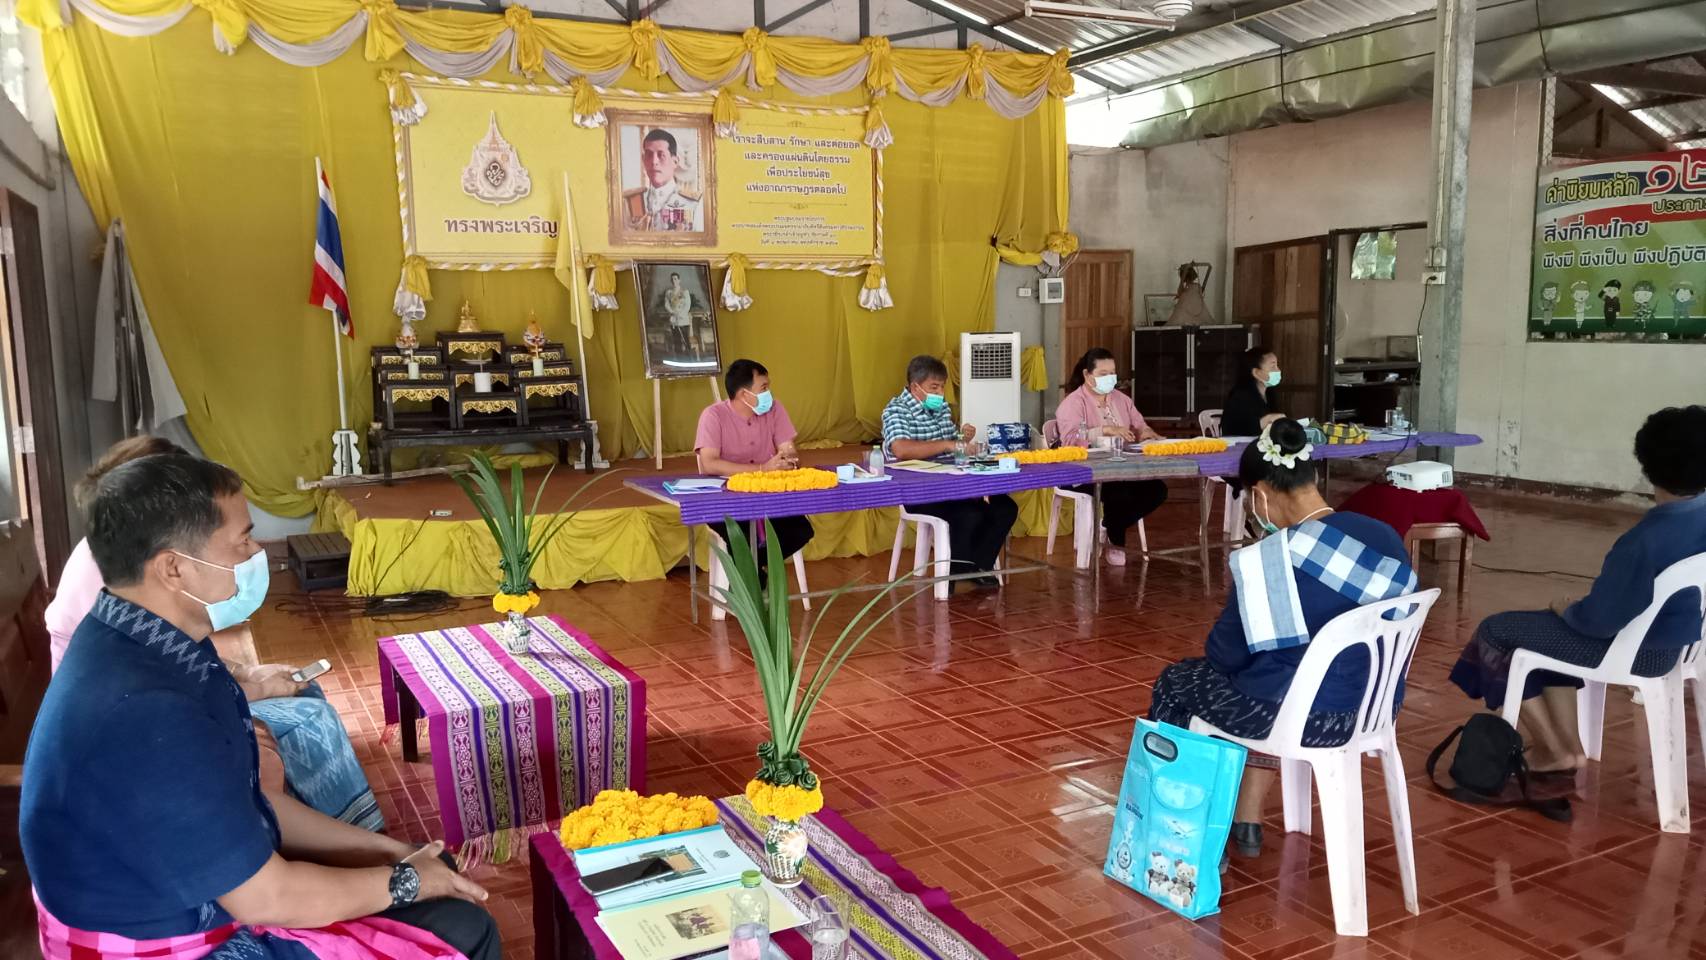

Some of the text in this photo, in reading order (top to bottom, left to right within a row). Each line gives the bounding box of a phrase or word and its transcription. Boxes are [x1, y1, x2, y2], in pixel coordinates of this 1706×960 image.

[789, 136, 811, 147] รักษา
[766, 166, 830, 181] เพื่อประโยชน์สุข
[1545, 172, 1640, 204] ค่านิยมหลัก
[1653, 198, 1706, 214] ประกา
[444, 215, 558, 239] ทรงพระเจริญ
[1544, 215, 1649, 243] สิ่งที่คนไทย
[1543, 245, 1706, 269] พึงมี พึงเป็น พึงปฏิบัติ
